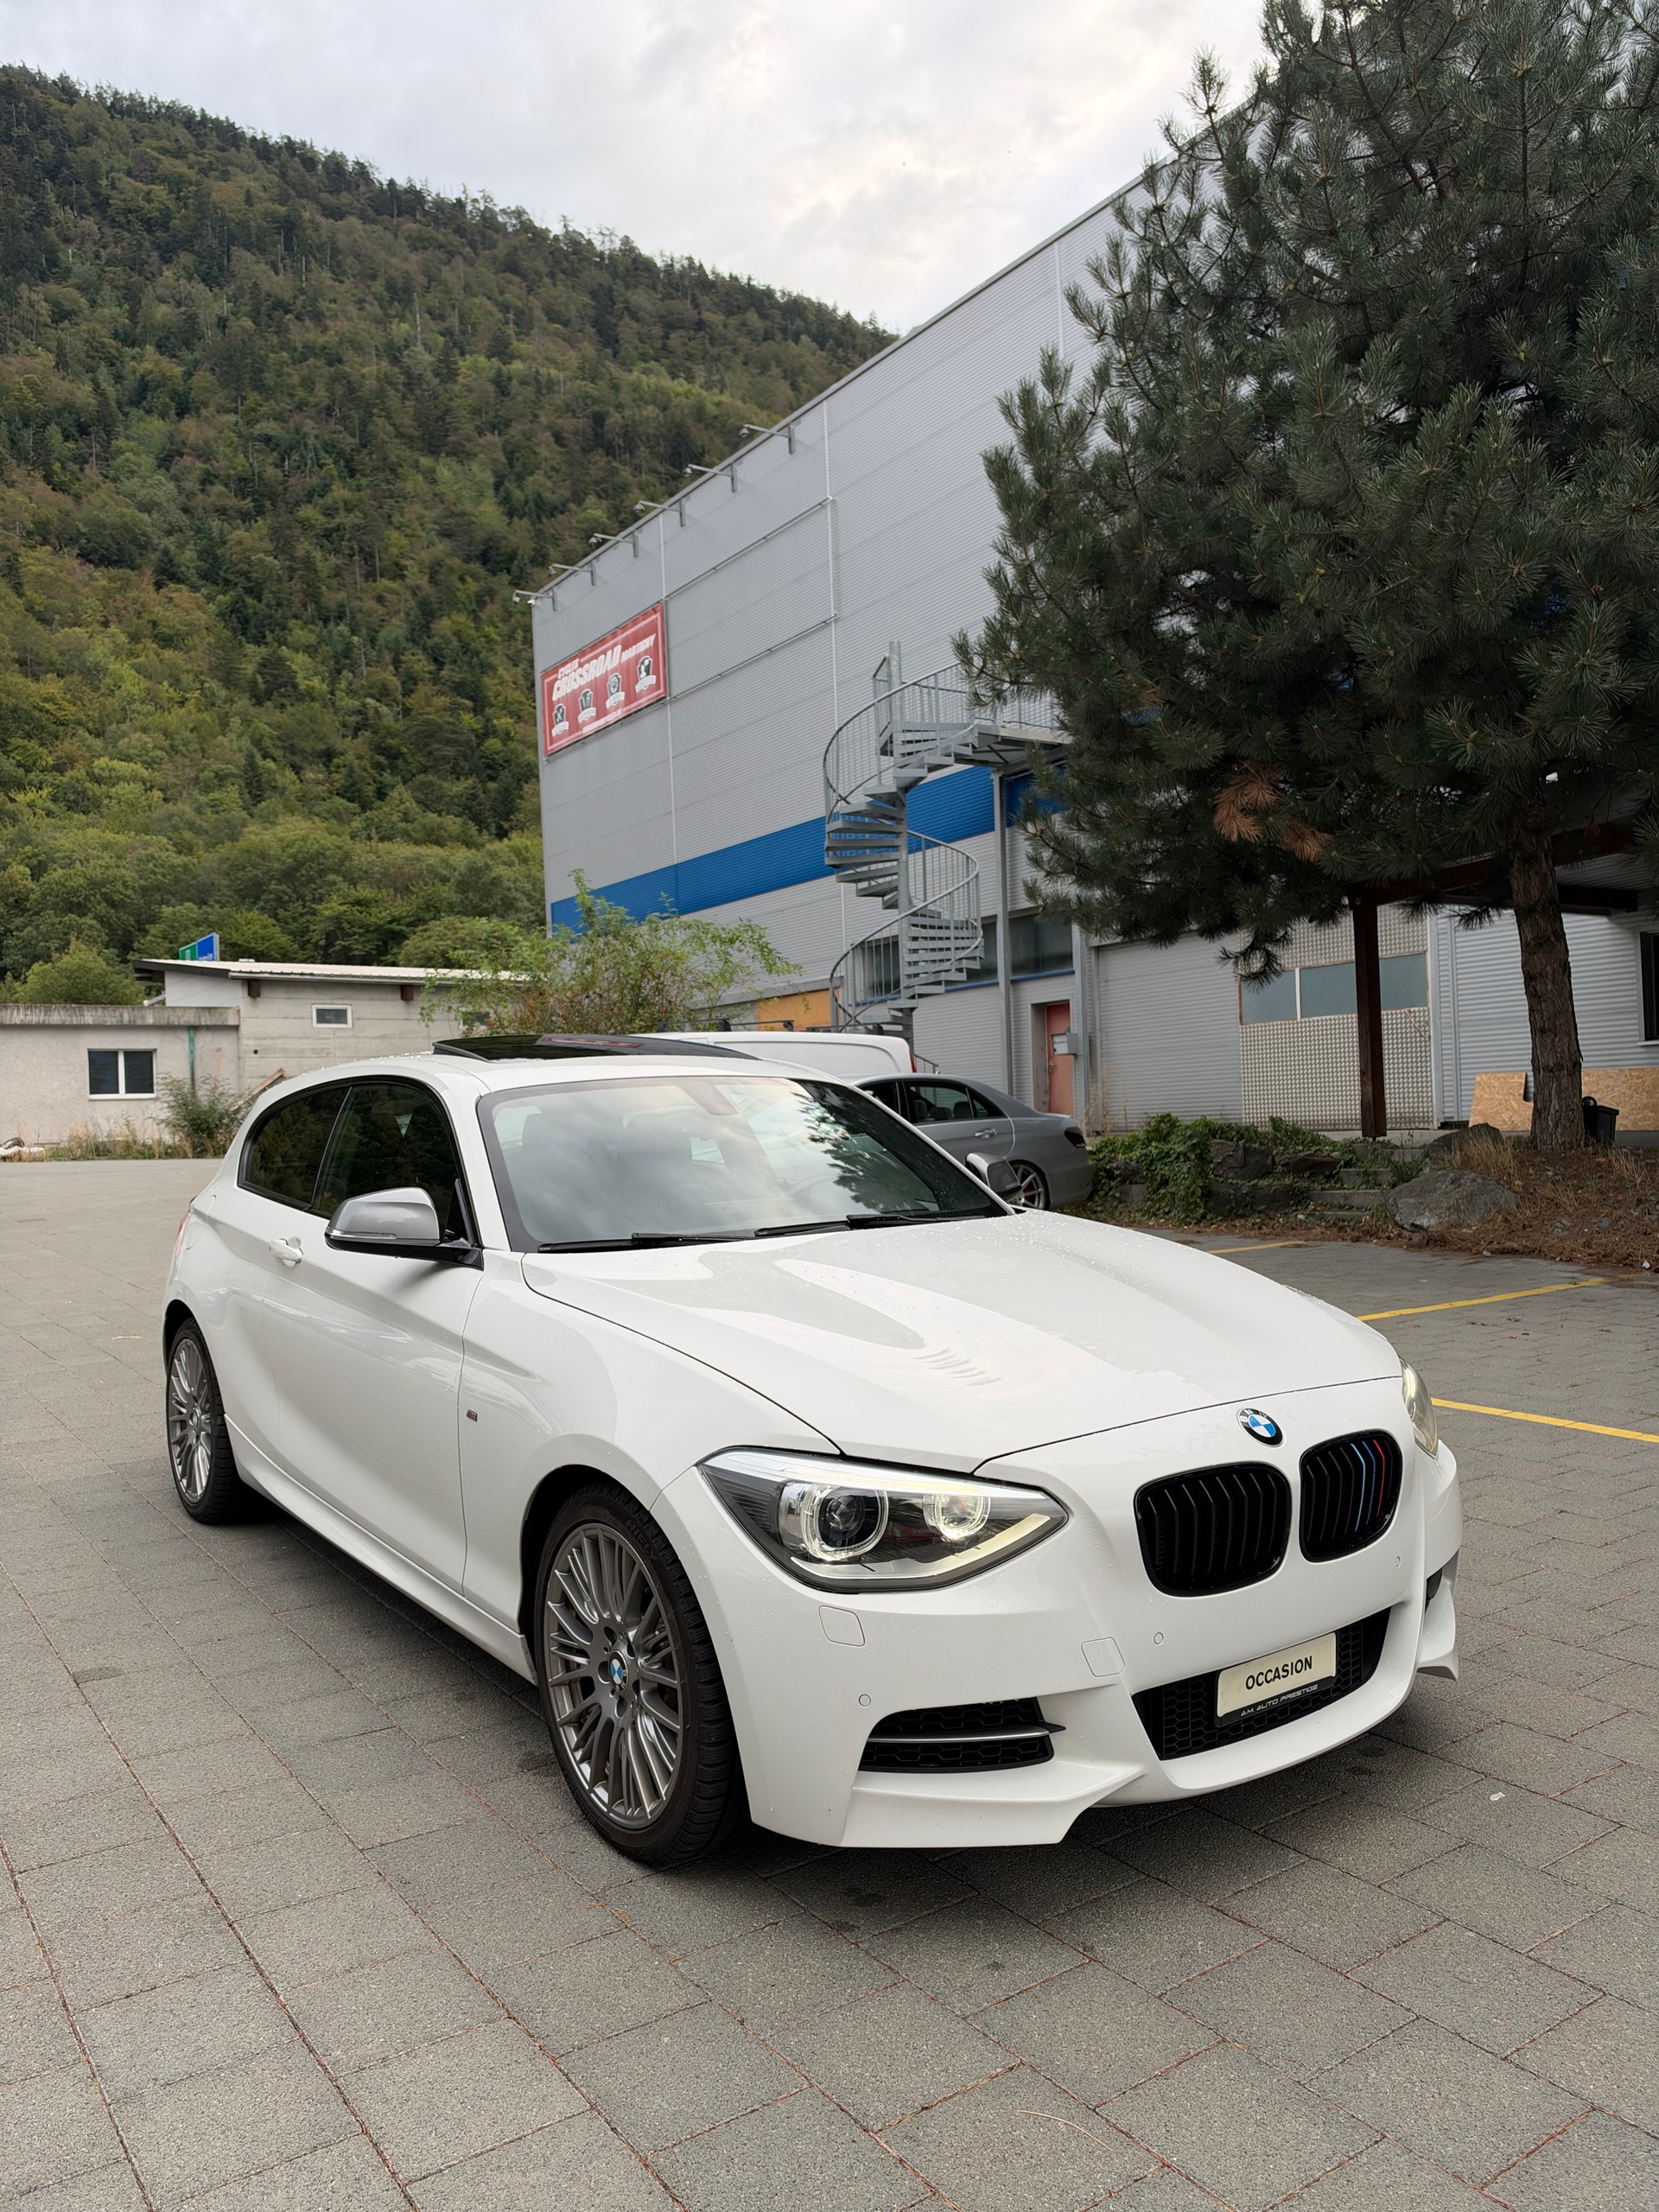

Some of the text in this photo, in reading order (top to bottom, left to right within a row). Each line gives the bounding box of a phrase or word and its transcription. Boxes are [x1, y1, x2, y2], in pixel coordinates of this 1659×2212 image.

[552, 645, 621, 702] CROSSROAD
[625, 1519, 658, 1561] HIFLY
[1245, 1656, 1313, 1690] OCCASION
[1256, 1699, 1279, 1711] AUTO
[1280, 1683, 1319, 1702] PRESTIGE
